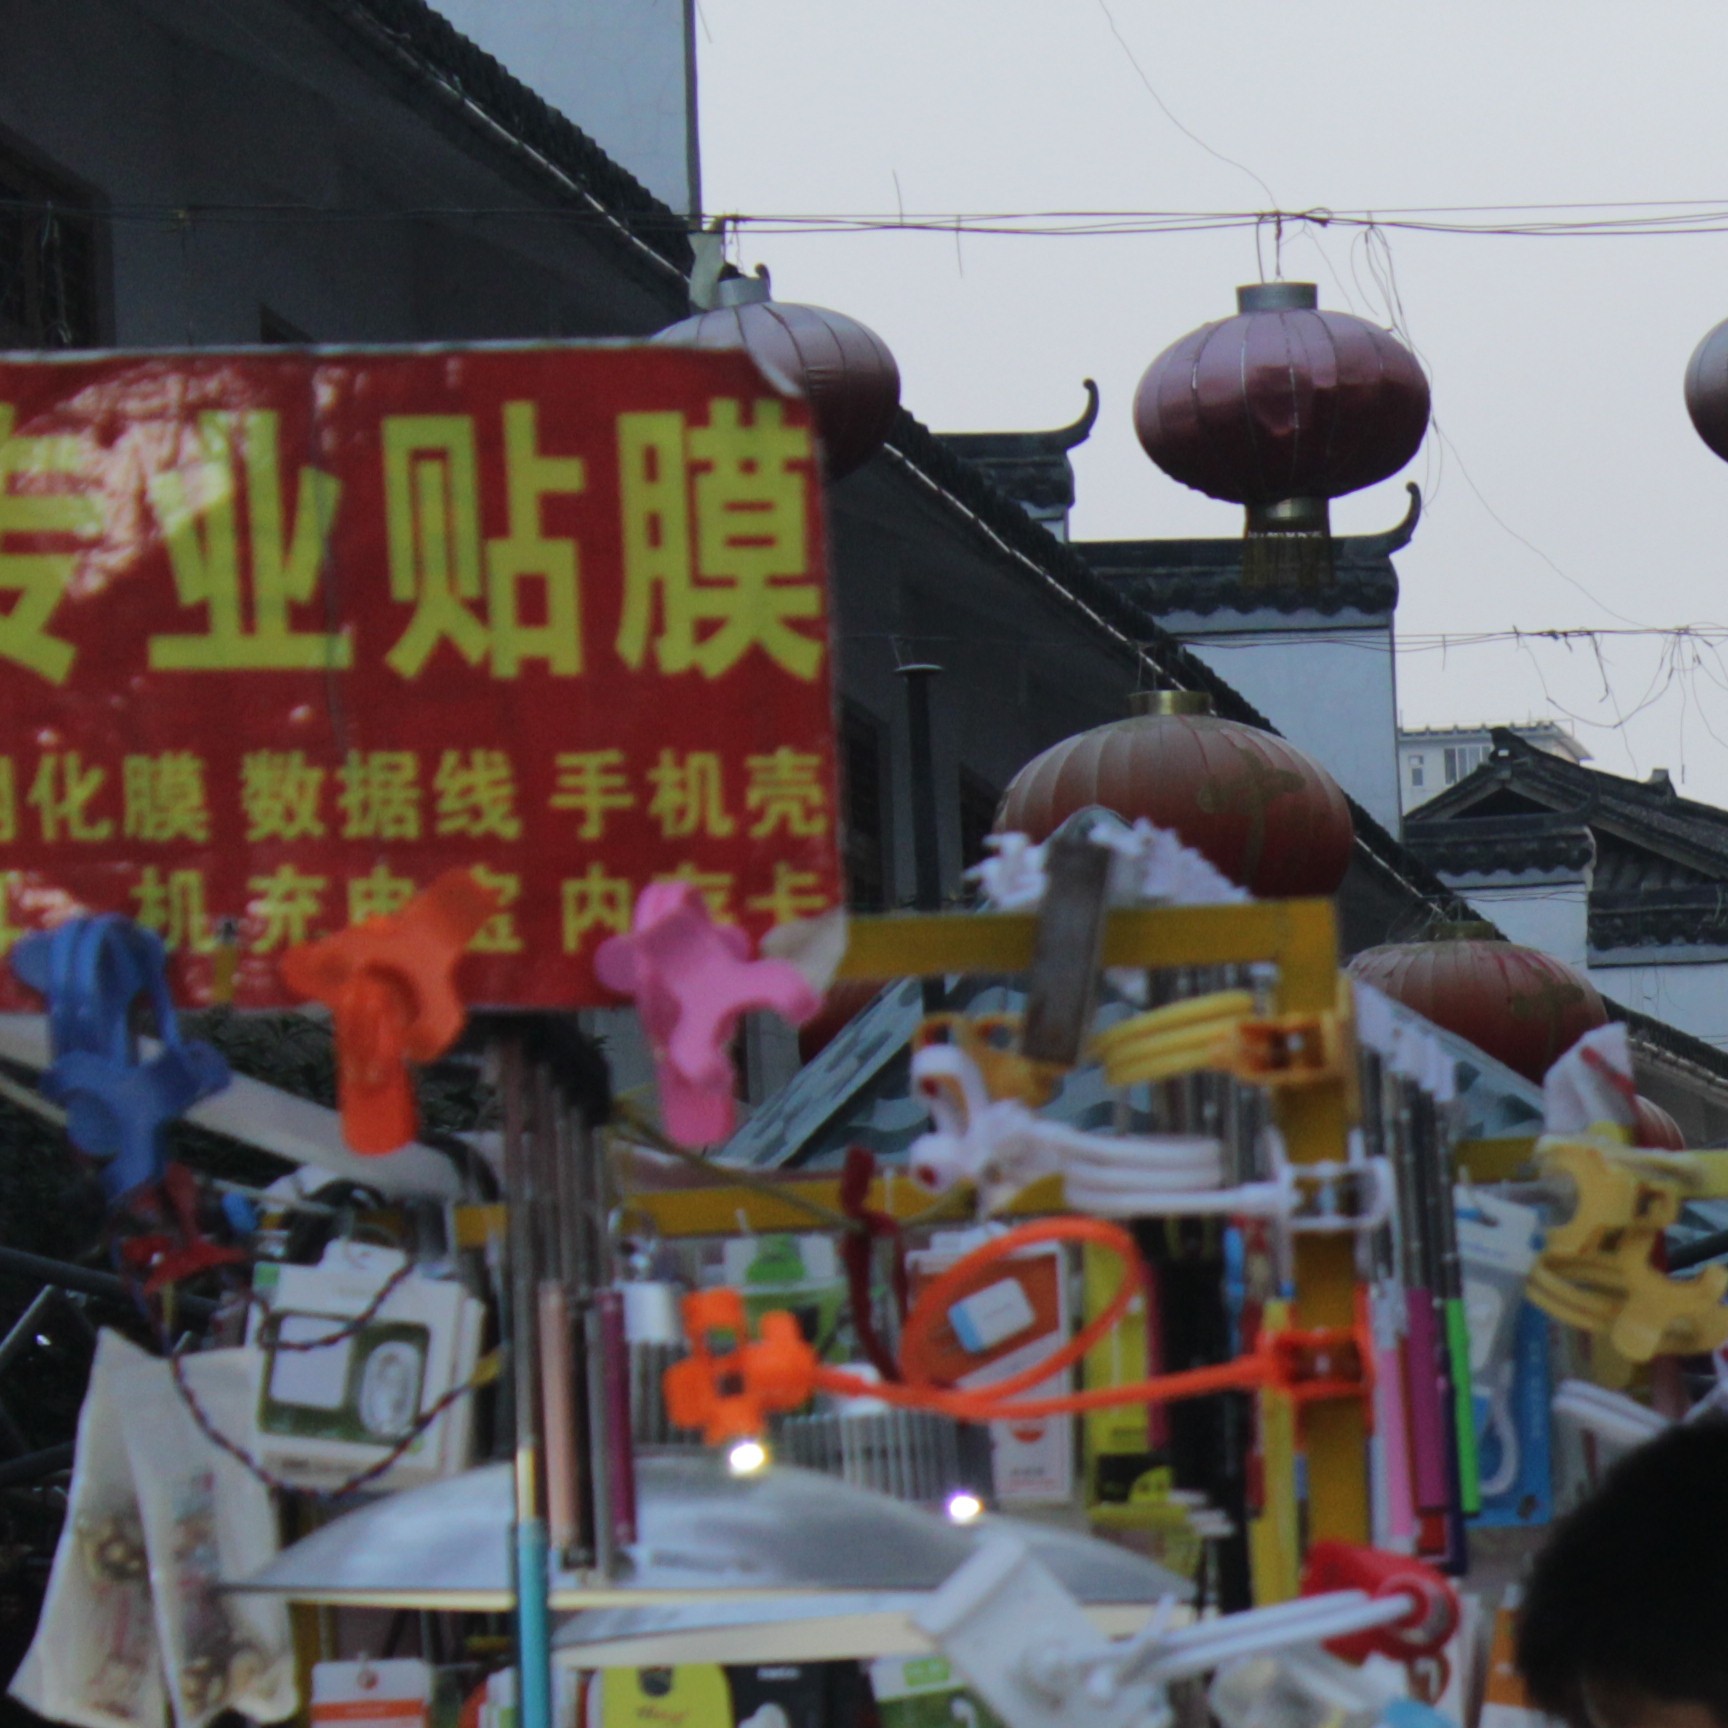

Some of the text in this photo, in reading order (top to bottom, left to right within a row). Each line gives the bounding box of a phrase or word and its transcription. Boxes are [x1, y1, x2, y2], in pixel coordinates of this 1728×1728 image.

[0, 398, 825, 683] 专业贴膜
[0, 745, 827, 844] 化膜 数据线 手机壳
